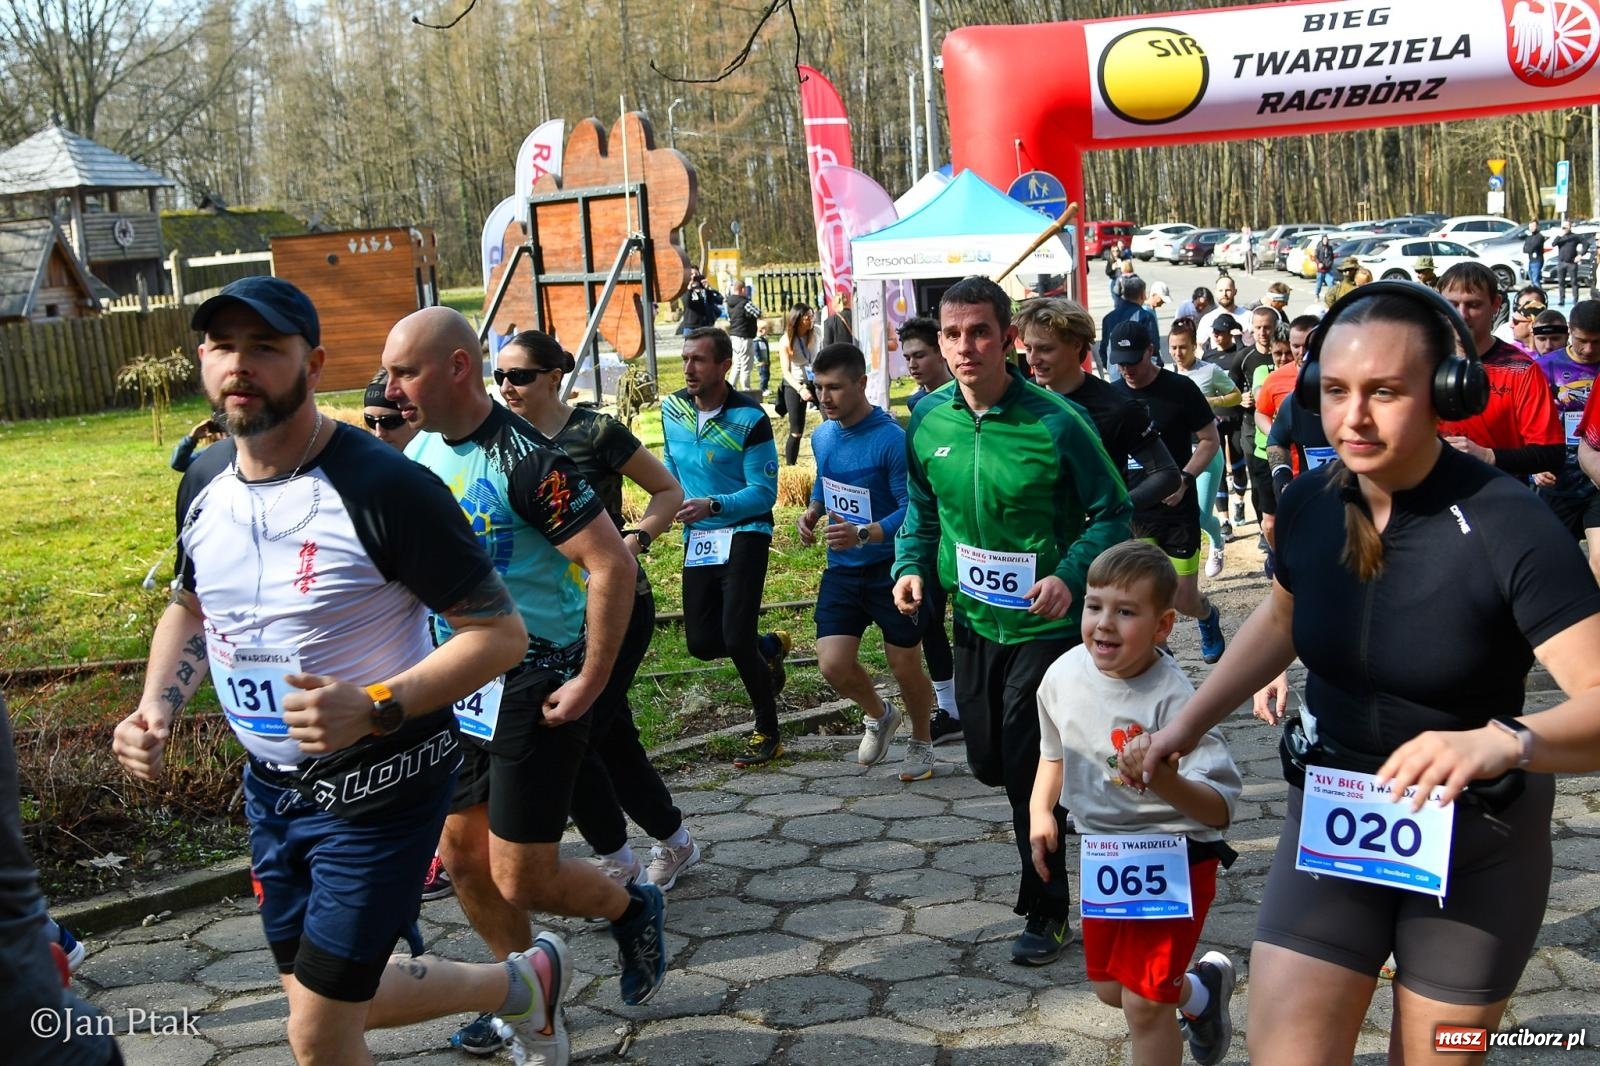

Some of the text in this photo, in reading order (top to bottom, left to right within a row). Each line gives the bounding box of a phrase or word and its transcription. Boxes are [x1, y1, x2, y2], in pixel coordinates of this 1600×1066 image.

[1302, 6, 1392, 33] BIEG
[1233, 33, 1472, 79] TWARDZIELA
[1256, 75, 1448, 116] RACIBÓRZ
[832, 494, 860, 514] 105
[969, 565, 1019, 593] 056
[226, 676, 278, 713] 131
[1313, 786, 1364, 800] 15 marzec 2026
[1314, 773, 1334, 786] XIV
[1337, 776, 1365, 792] BIEG
[1085, 839, 1178, 851] XIV BIEG TWARDZIELA
[1325, 806, 1423, 858] 020
[1096, 864, 1168, 896] 065
